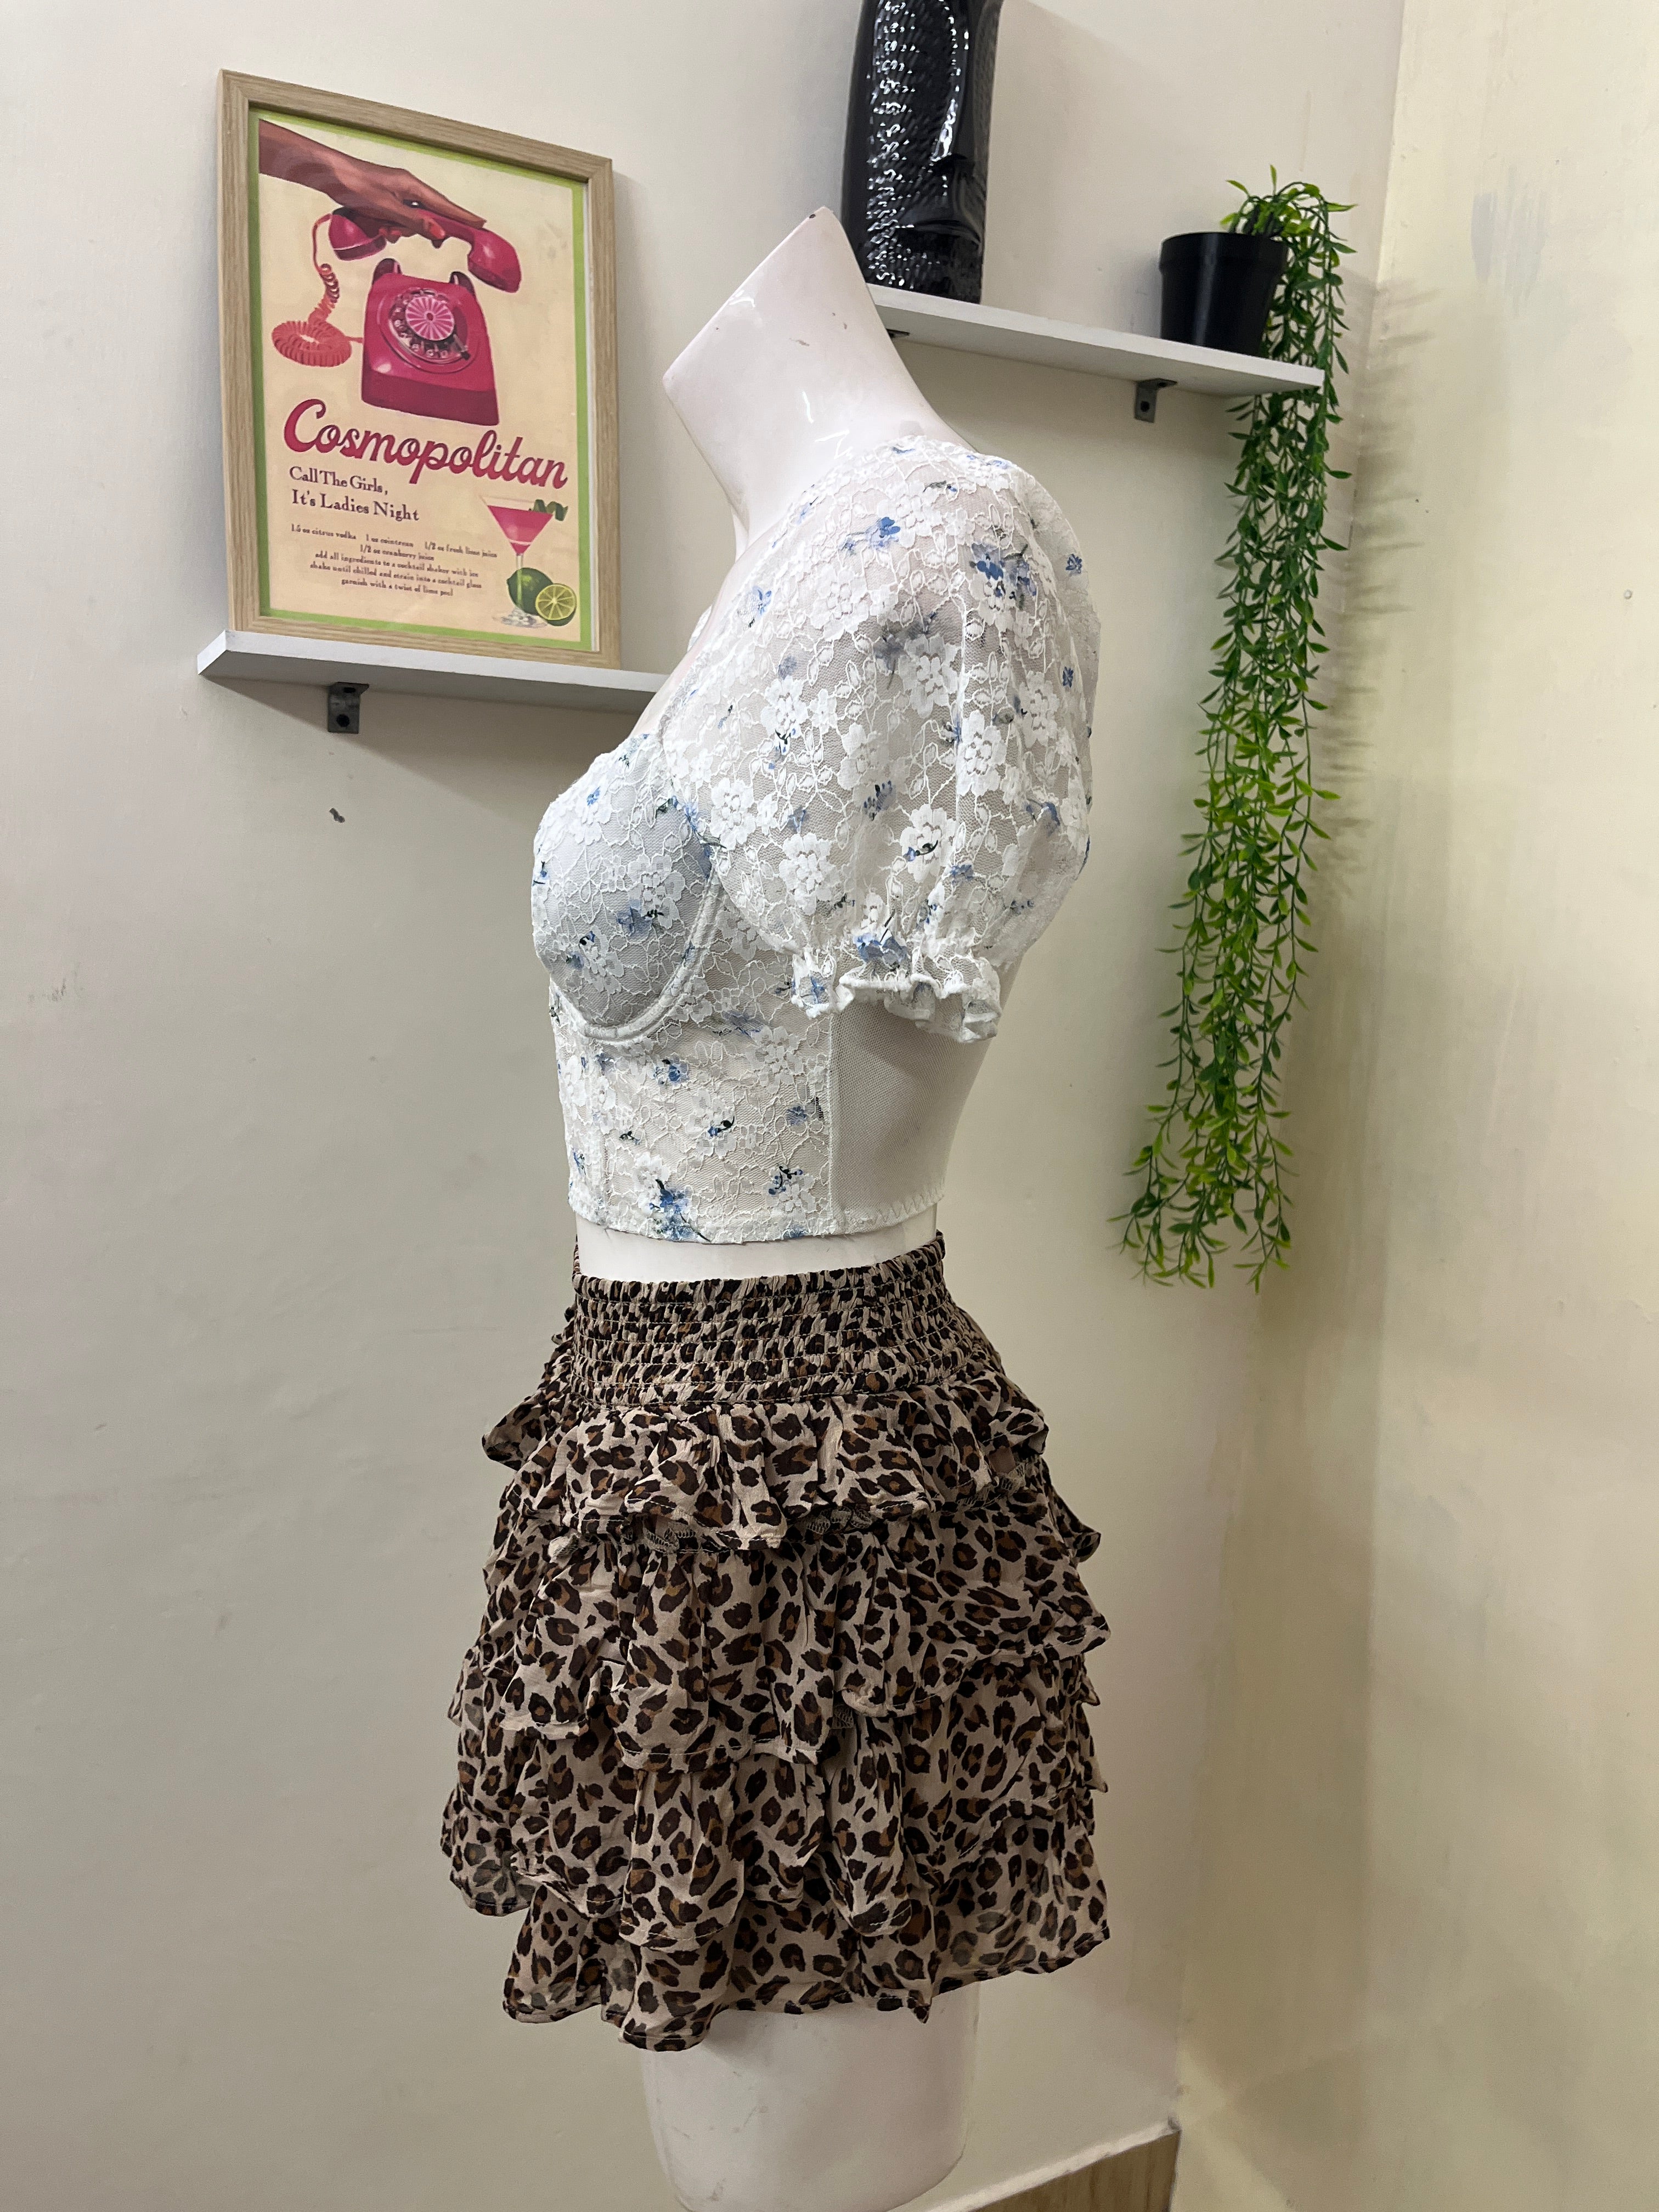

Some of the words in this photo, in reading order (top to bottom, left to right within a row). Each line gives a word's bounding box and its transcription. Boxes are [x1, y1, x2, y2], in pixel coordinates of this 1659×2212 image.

[283, 398, 569, 489] Cosmopolitan
[289, 466, 318, 483] Call
[319, 470, 348, 487] The
[349, 475, 388, 495] Girls,
[292, 488, 316, 506] It's
[319, 492, 370, 514] Ladies
[373, 500, 420, 521] Night
